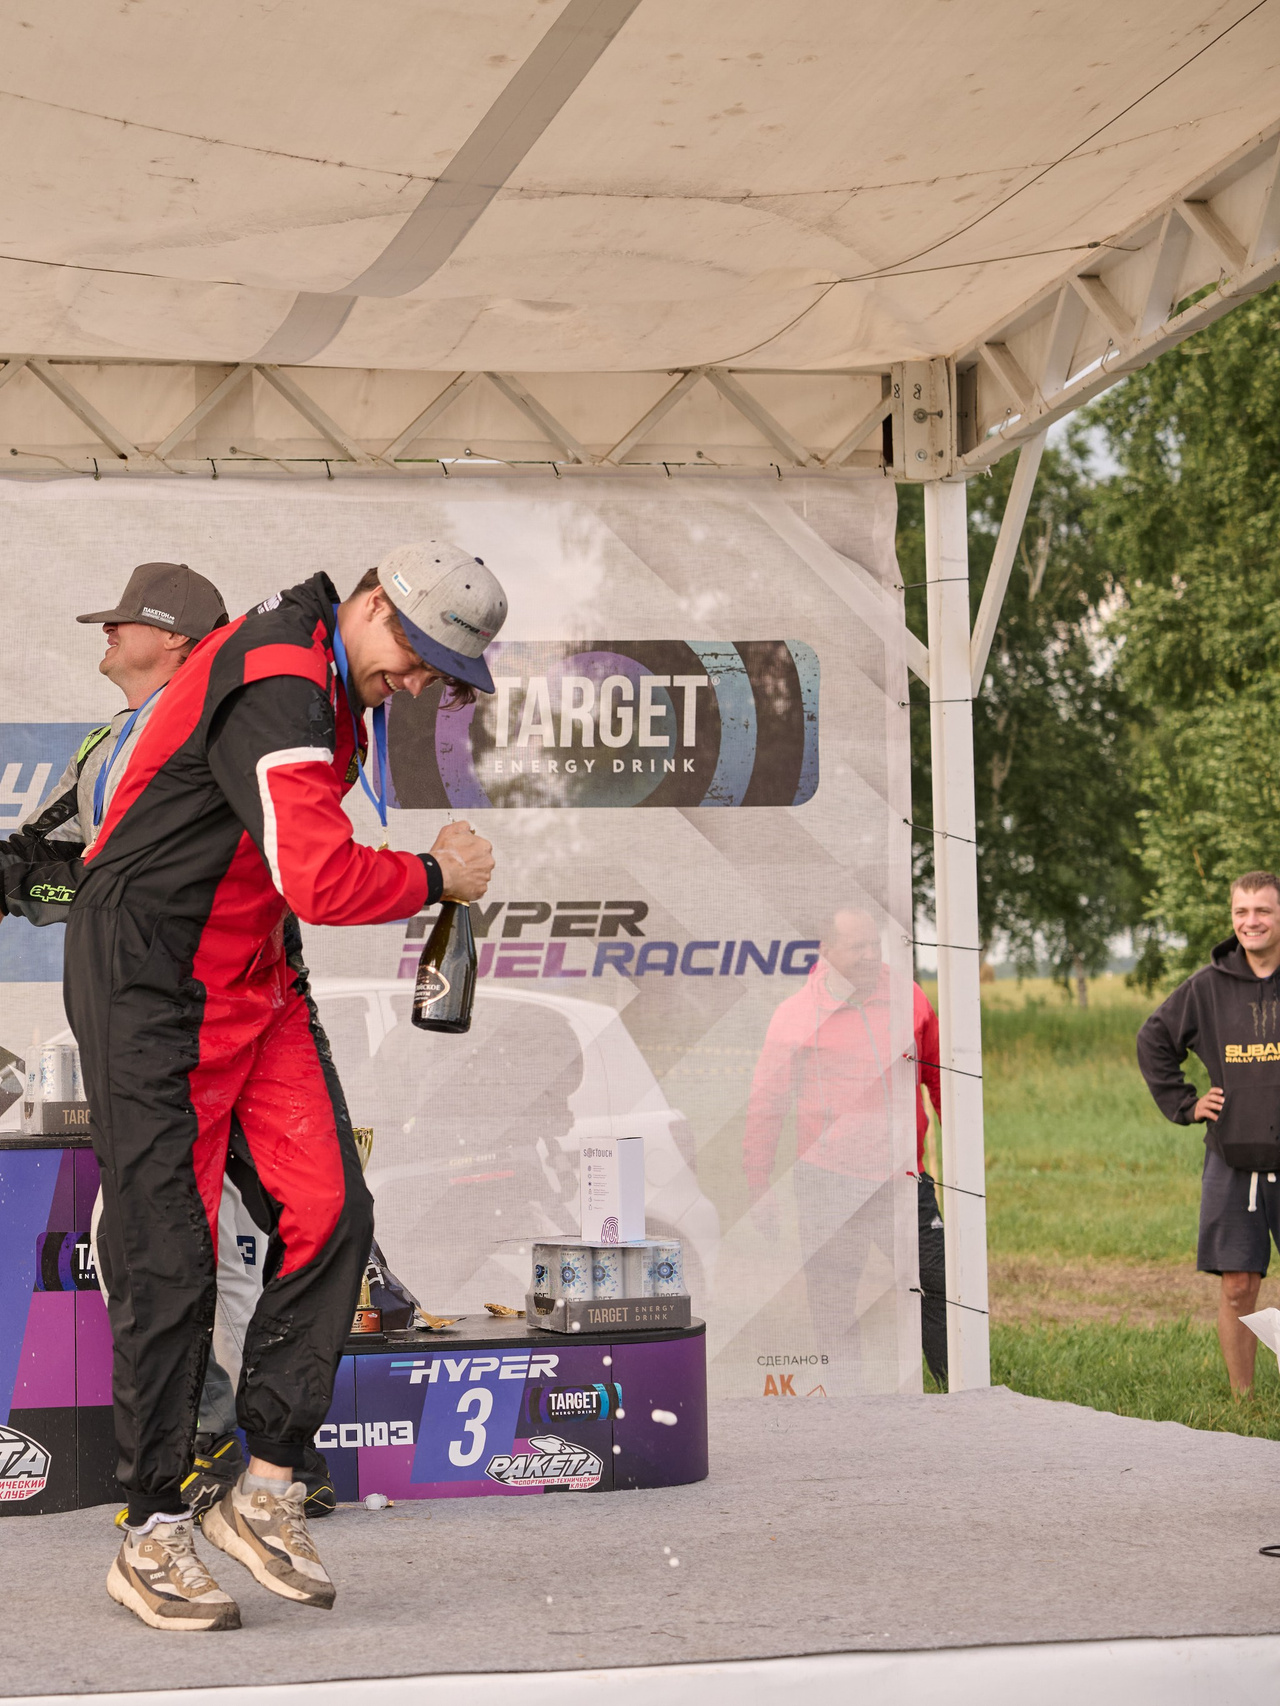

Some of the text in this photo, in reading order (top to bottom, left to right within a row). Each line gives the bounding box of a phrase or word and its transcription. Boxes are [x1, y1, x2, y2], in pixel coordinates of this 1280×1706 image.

[494, 674, 709, 749] TARGET
[494, 757, 696, 774] ENERGY DRINK
[591, 939, 822, 978] RACING
[1225, 1042, 1280, 1057] SUBA
[356, 1313, 364, 1322] 3
[588, 1304, 675, 1324] TARGET ENERGY
[635, 1313, 668, 1322] DRINK
[409, 1353, 560, 1384] HYPER
[756, 1354, 830, 1367] СДЕЛАНО В
[549, 1391, 599, 1410] TARGET
[313, 1420, 414, 1449] СОЮЗ
[448, 1387, 494, 1467] 3
[486, 1453, 601, 1480] РАКЕТА
[518, 1476, 600, 1486] СПОРТИВНО-ТЕХНИЧЕСКИЙ
